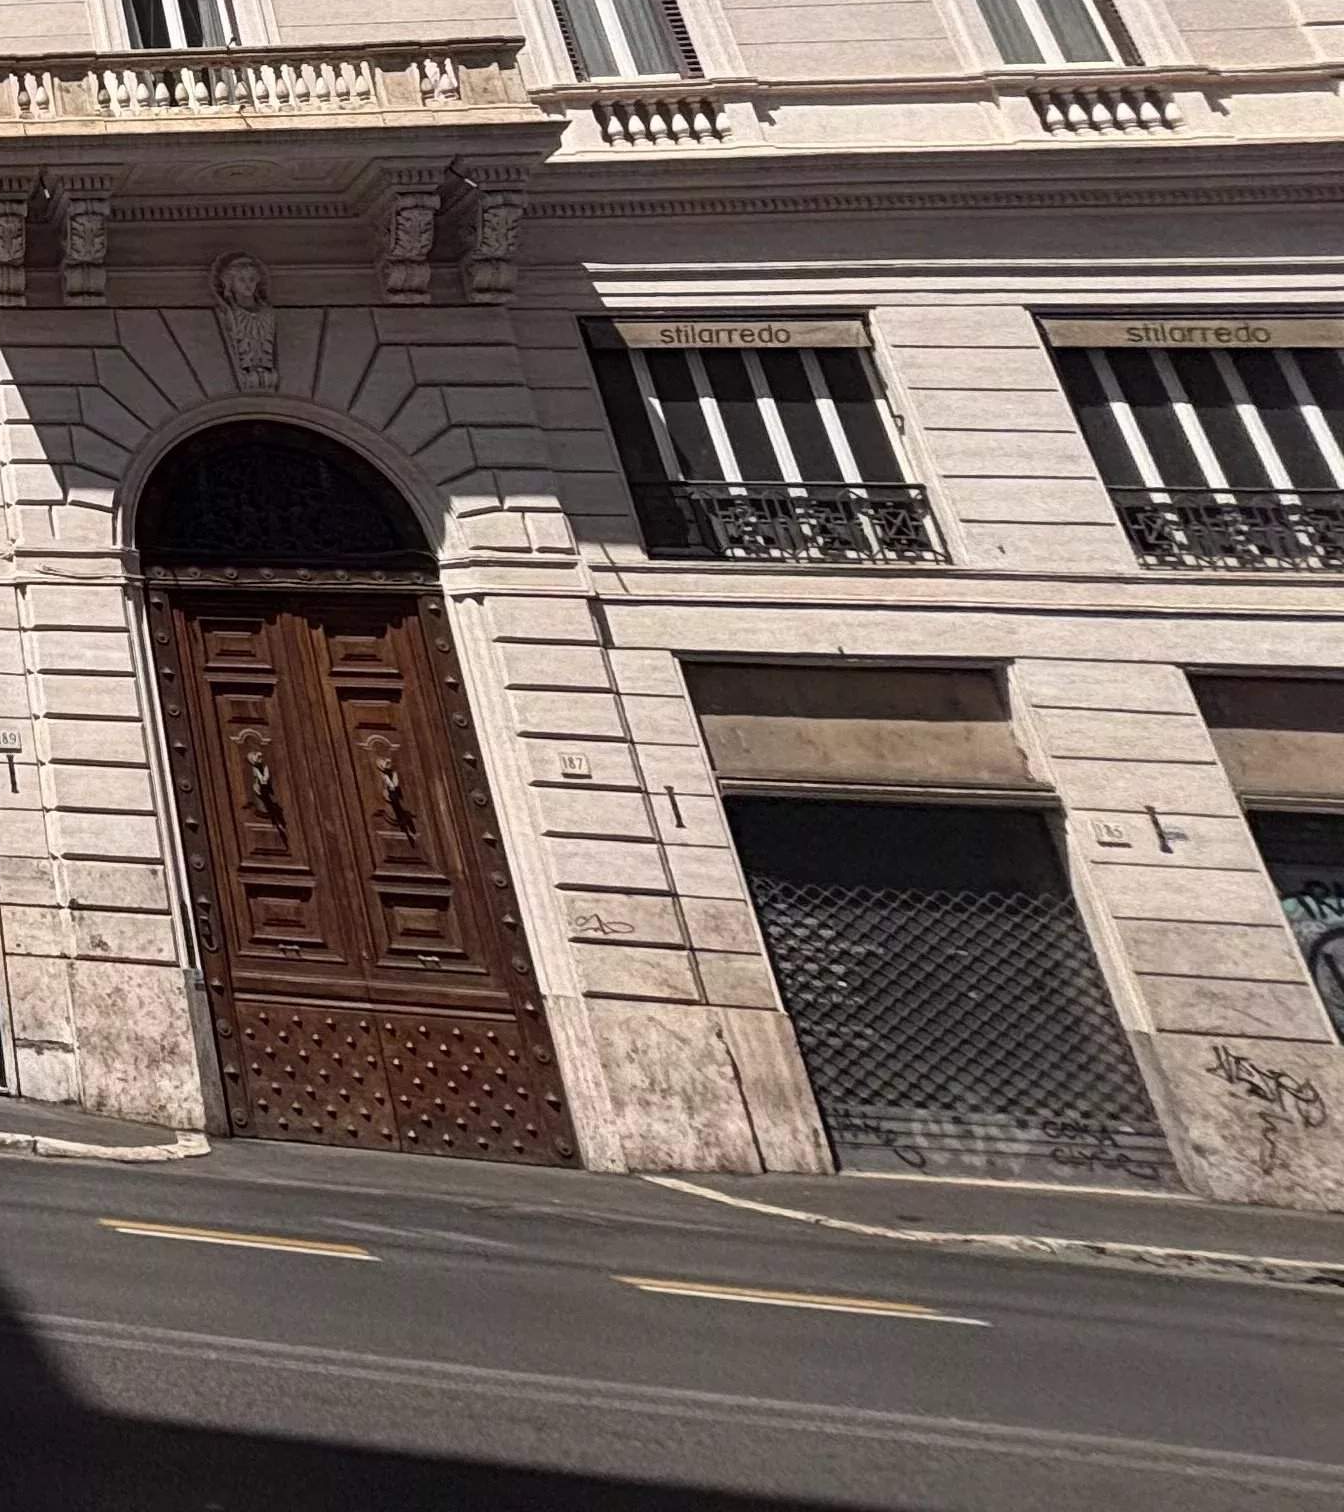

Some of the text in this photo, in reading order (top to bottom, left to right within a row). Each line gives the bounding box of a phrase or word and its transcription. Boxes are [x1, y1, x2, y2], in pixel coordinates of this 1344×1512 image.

[659, 324, 791, 344] stilarredo
[1125, 321, 1272, 343] stilarredo
[562, 756, 583, 770] 187
